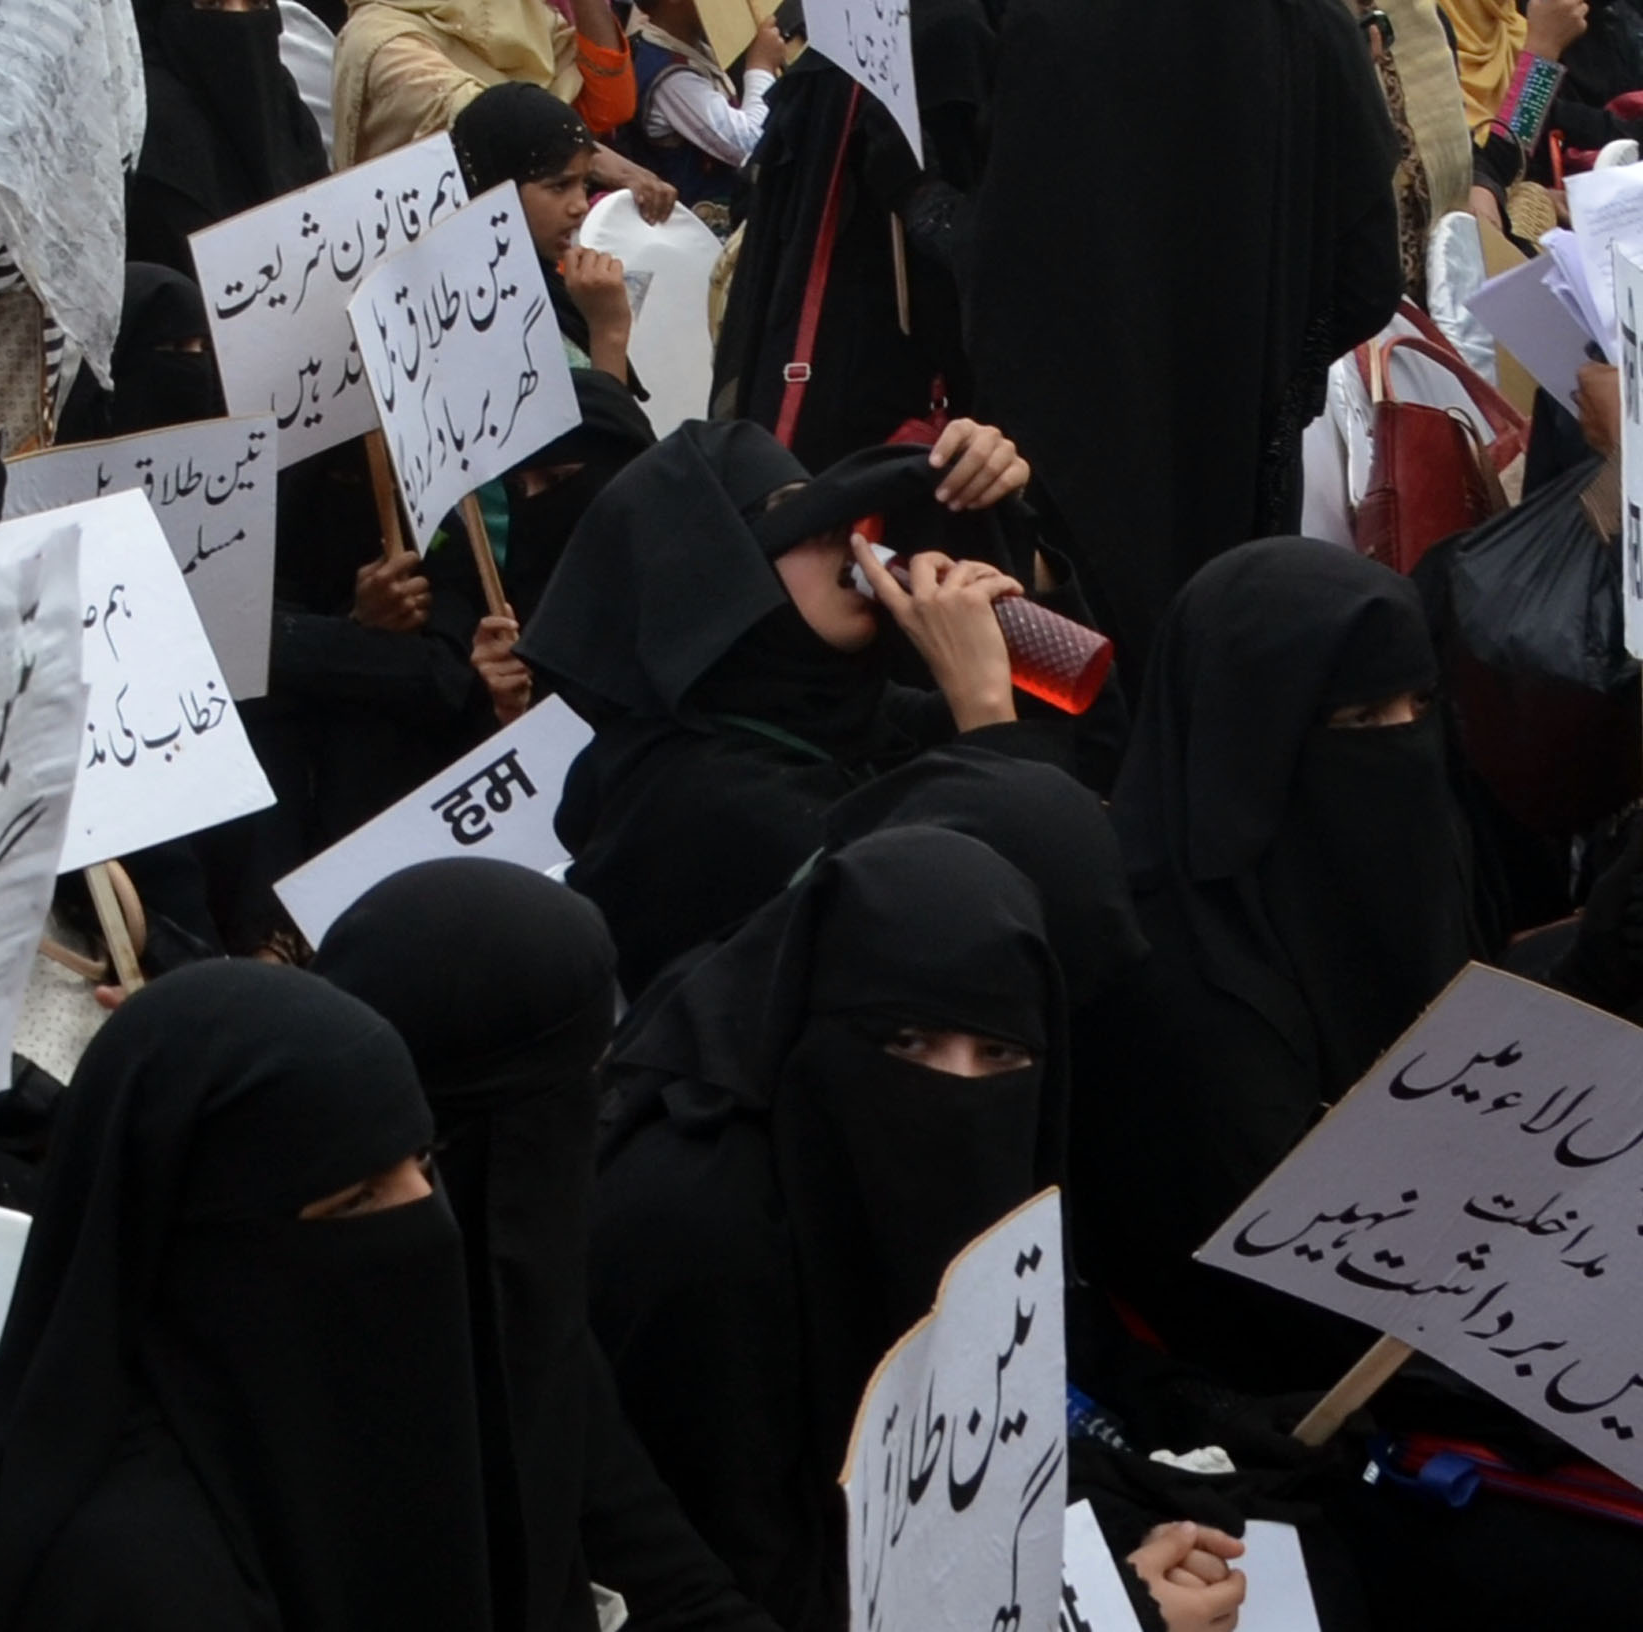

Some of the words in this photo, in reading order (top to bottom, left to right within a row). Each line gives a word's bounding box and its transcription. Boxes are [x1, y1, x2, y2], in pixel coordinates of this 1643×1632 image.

[396, 271, 463, 384] طلاق
[465, 211, 519, 334] تین
[429, 747, 539, 847] हम
